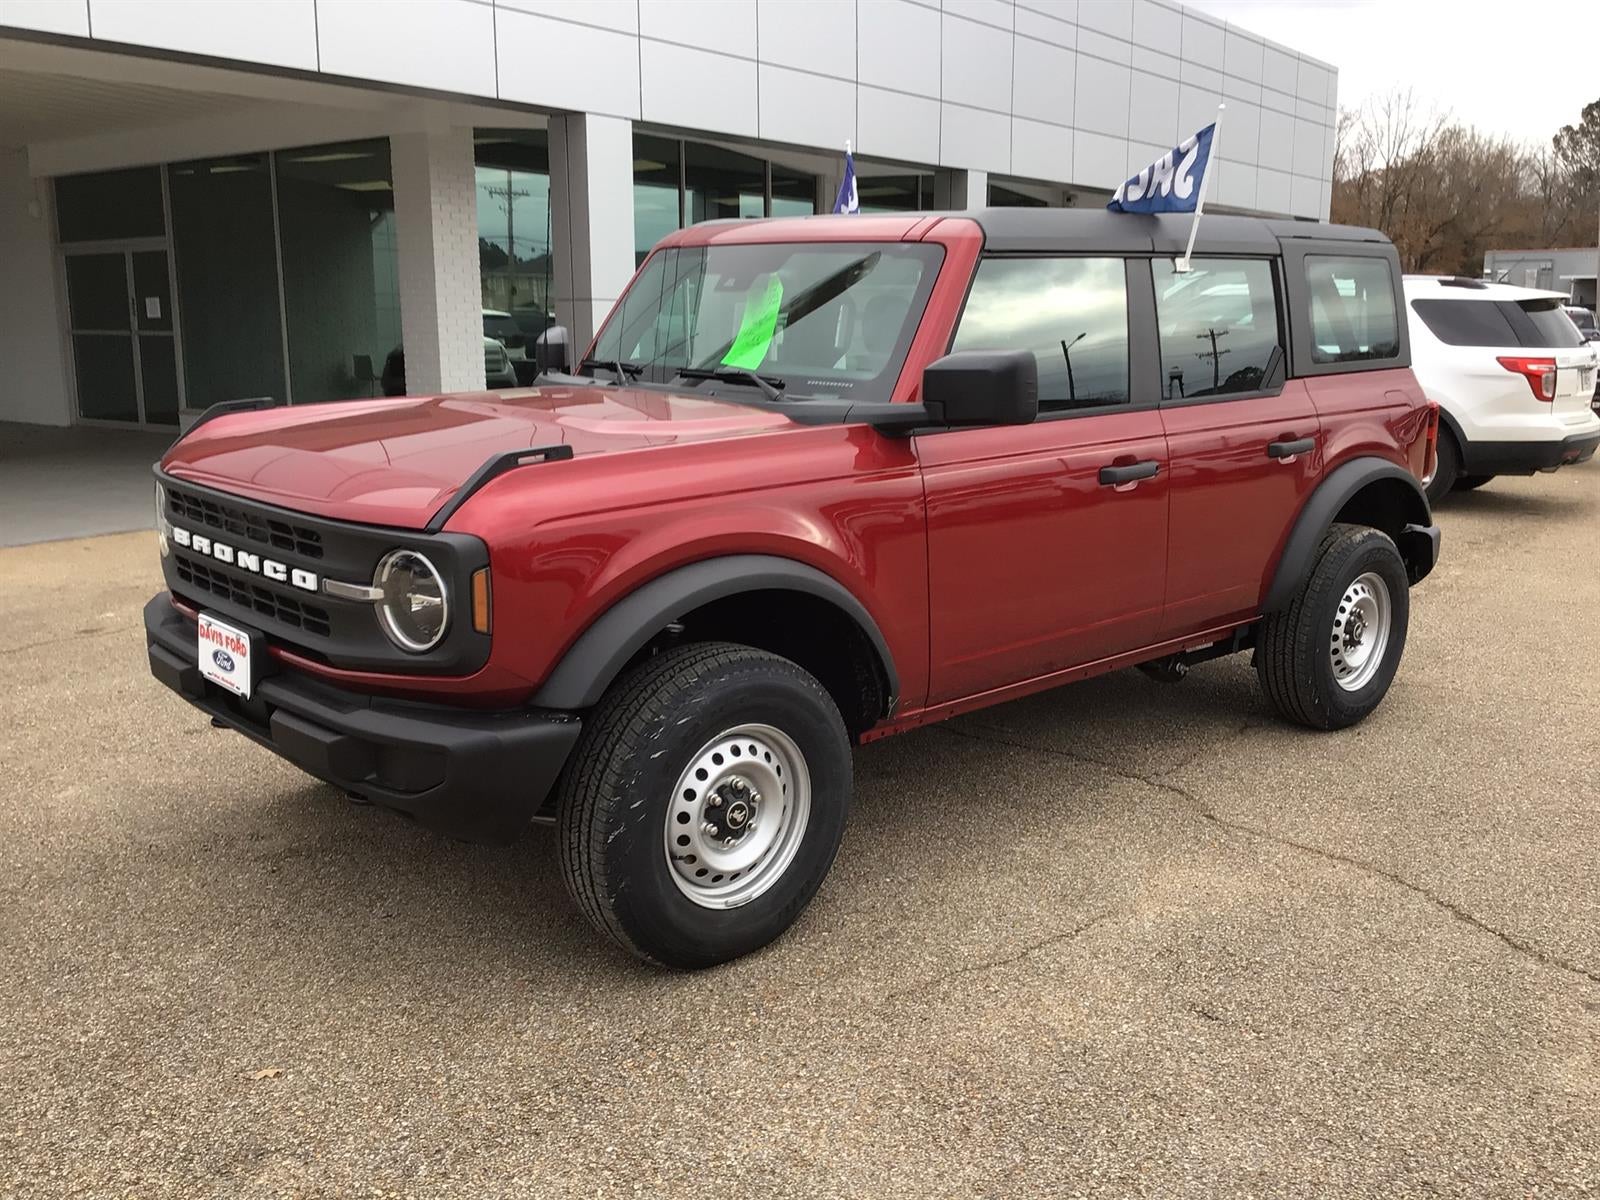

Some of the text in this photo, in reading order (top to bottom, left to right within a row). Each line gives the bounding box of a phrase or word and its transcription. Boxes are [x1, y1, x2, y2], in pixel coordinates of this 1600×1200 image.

[173, 527, 318, 591] BRONCO
[200, 624, 247, 657] DAVIS FORD
[215, 651, 232, 671] Ford
